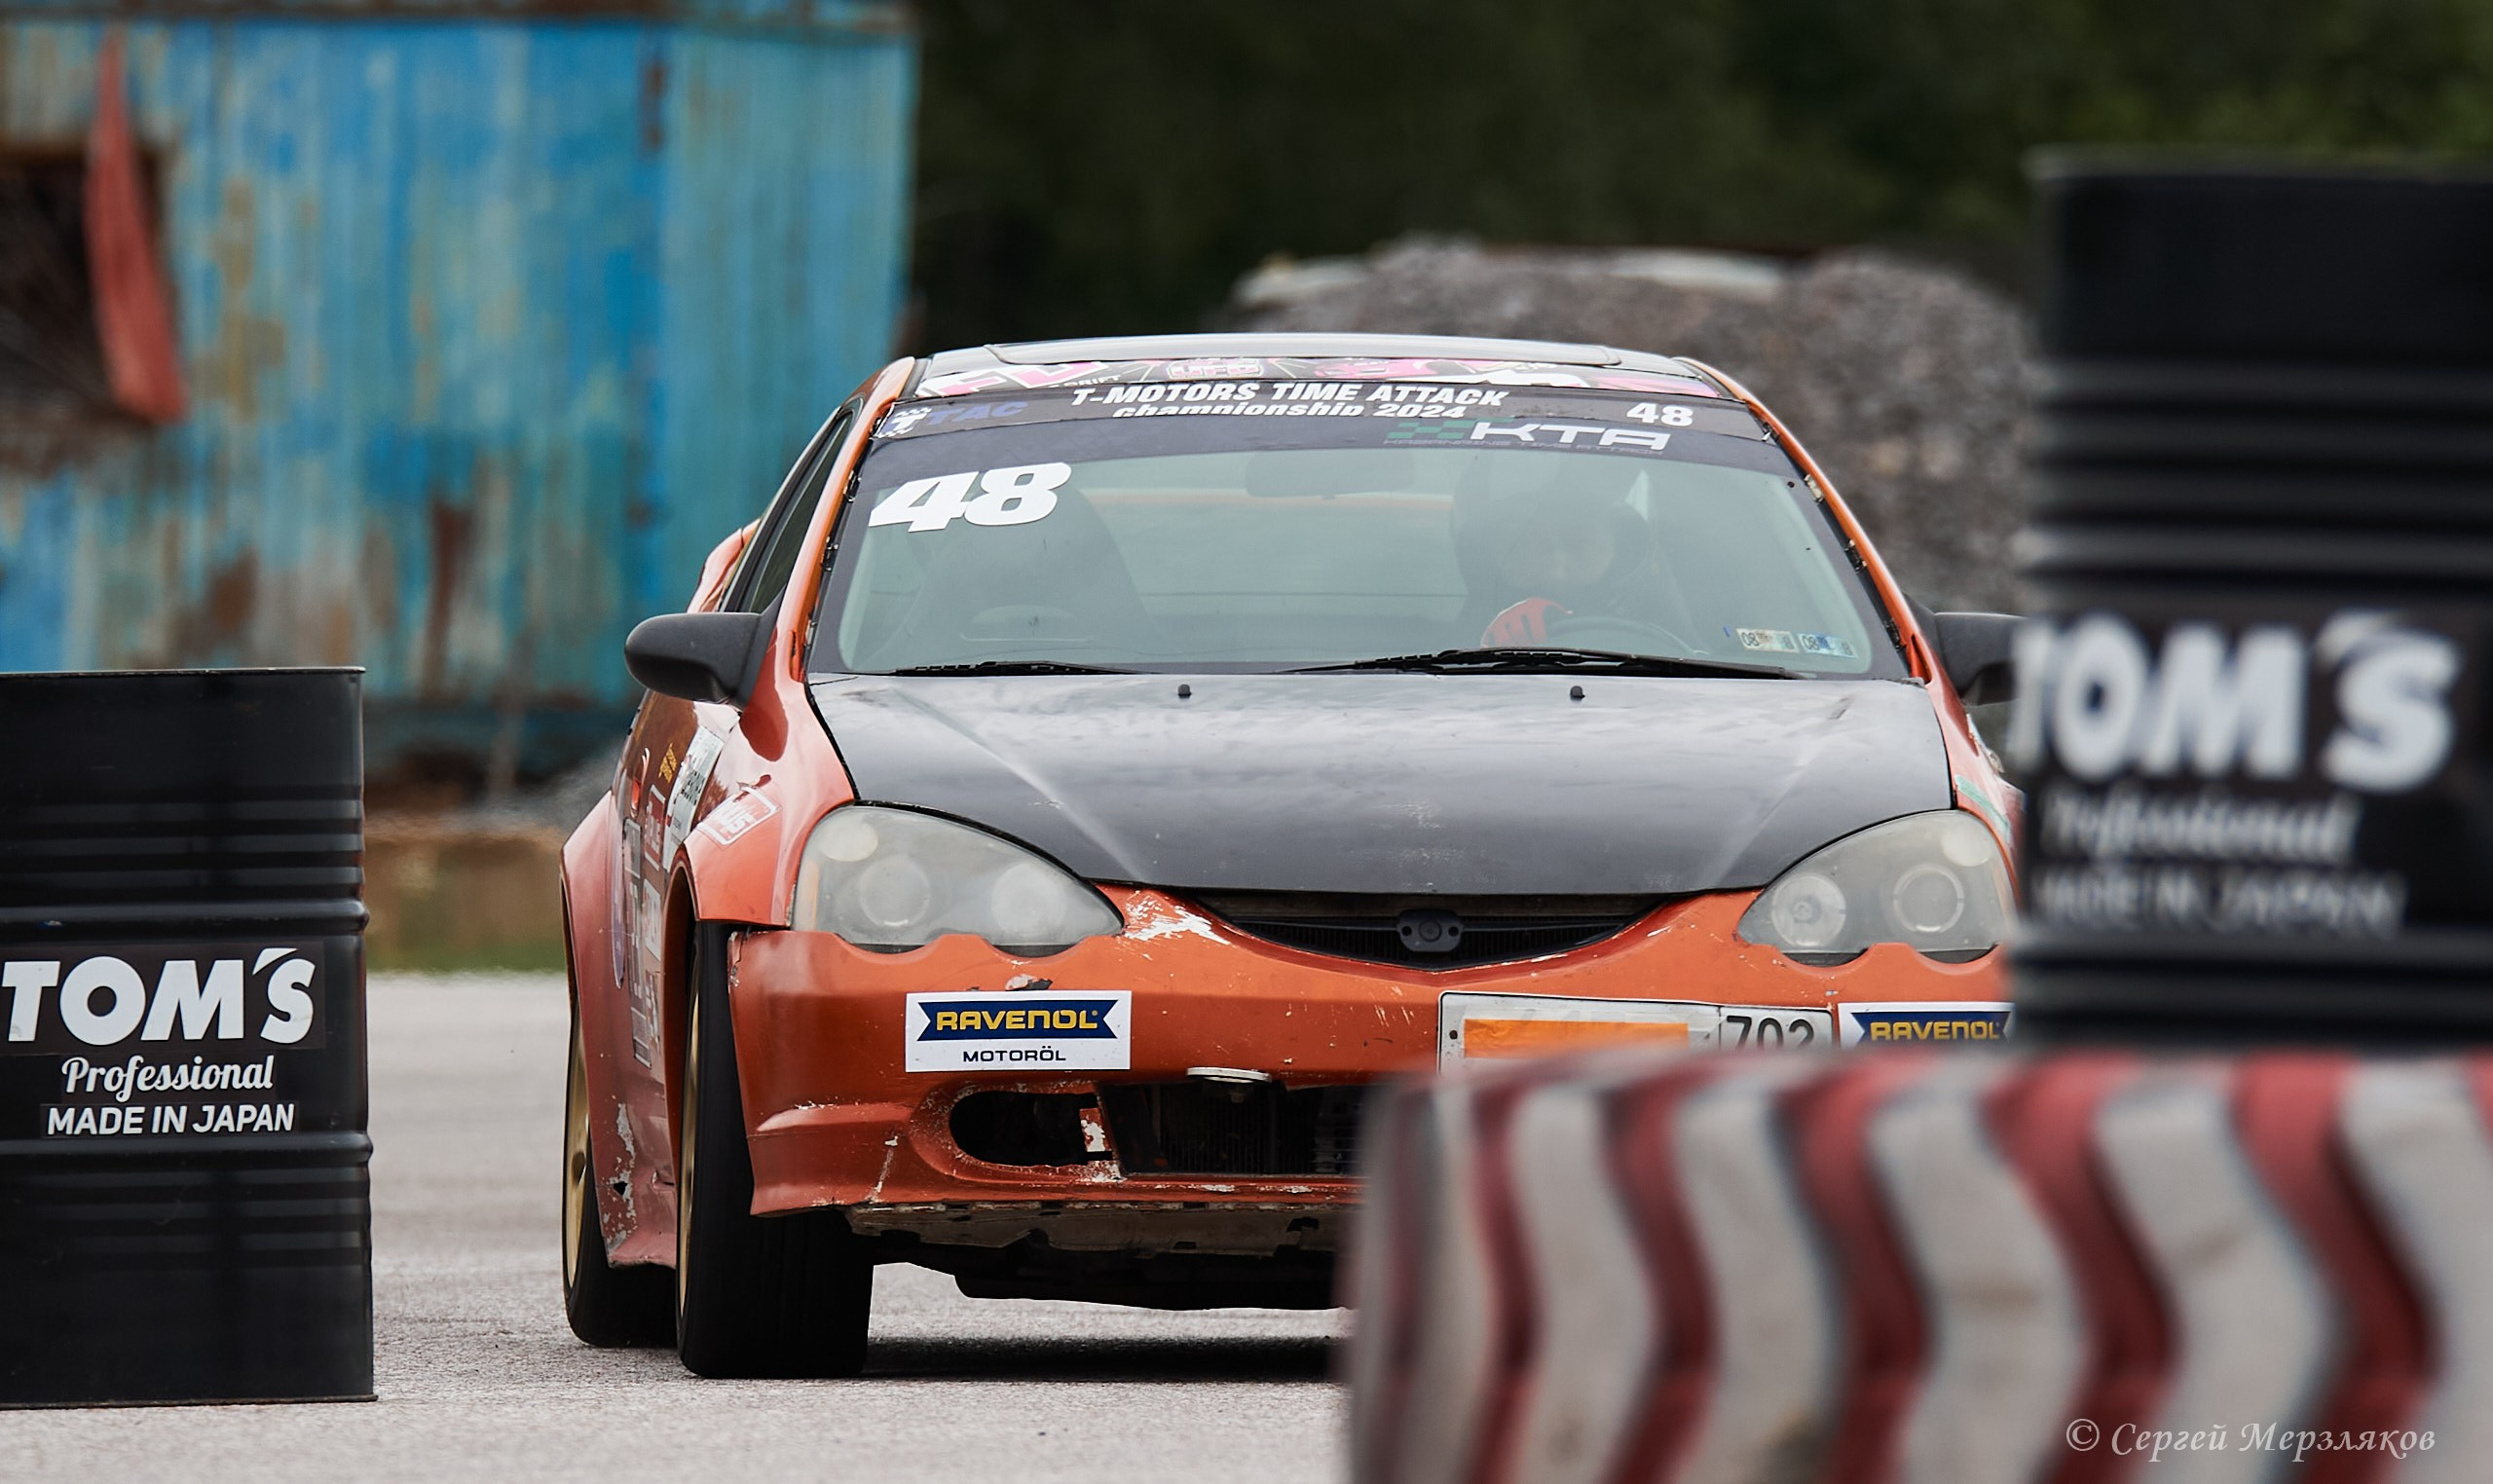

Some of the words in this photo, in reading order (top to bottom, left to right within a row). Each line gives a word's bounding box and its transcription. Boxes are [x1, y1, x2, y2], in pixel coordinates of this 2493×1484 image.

[1071, 382, 1260, 406] T-MOTORS
[1271, 382, 1363, 401] TIME
[1365, 384, 1509, 407] ATTACK
[1373, 402, 1467, 419] 2024
[1625, 401, 1693, 427] 48
[1470, 421, 1671, 451] KTA
[868, 462, 1071, 533] 48
[1, 947, 316, 1047] TOM'S
[936, 1009, 1098, 1031] RAVENOL
[962, 1045, 1066, 1062] MOTORÖL
[60, 1054, 276, 1103] Professional
[47, 1106, 146, 1135] MADE
[151, 1105, 188, 1134] IN
[192, 1103, 296, 1133] JAPAN
